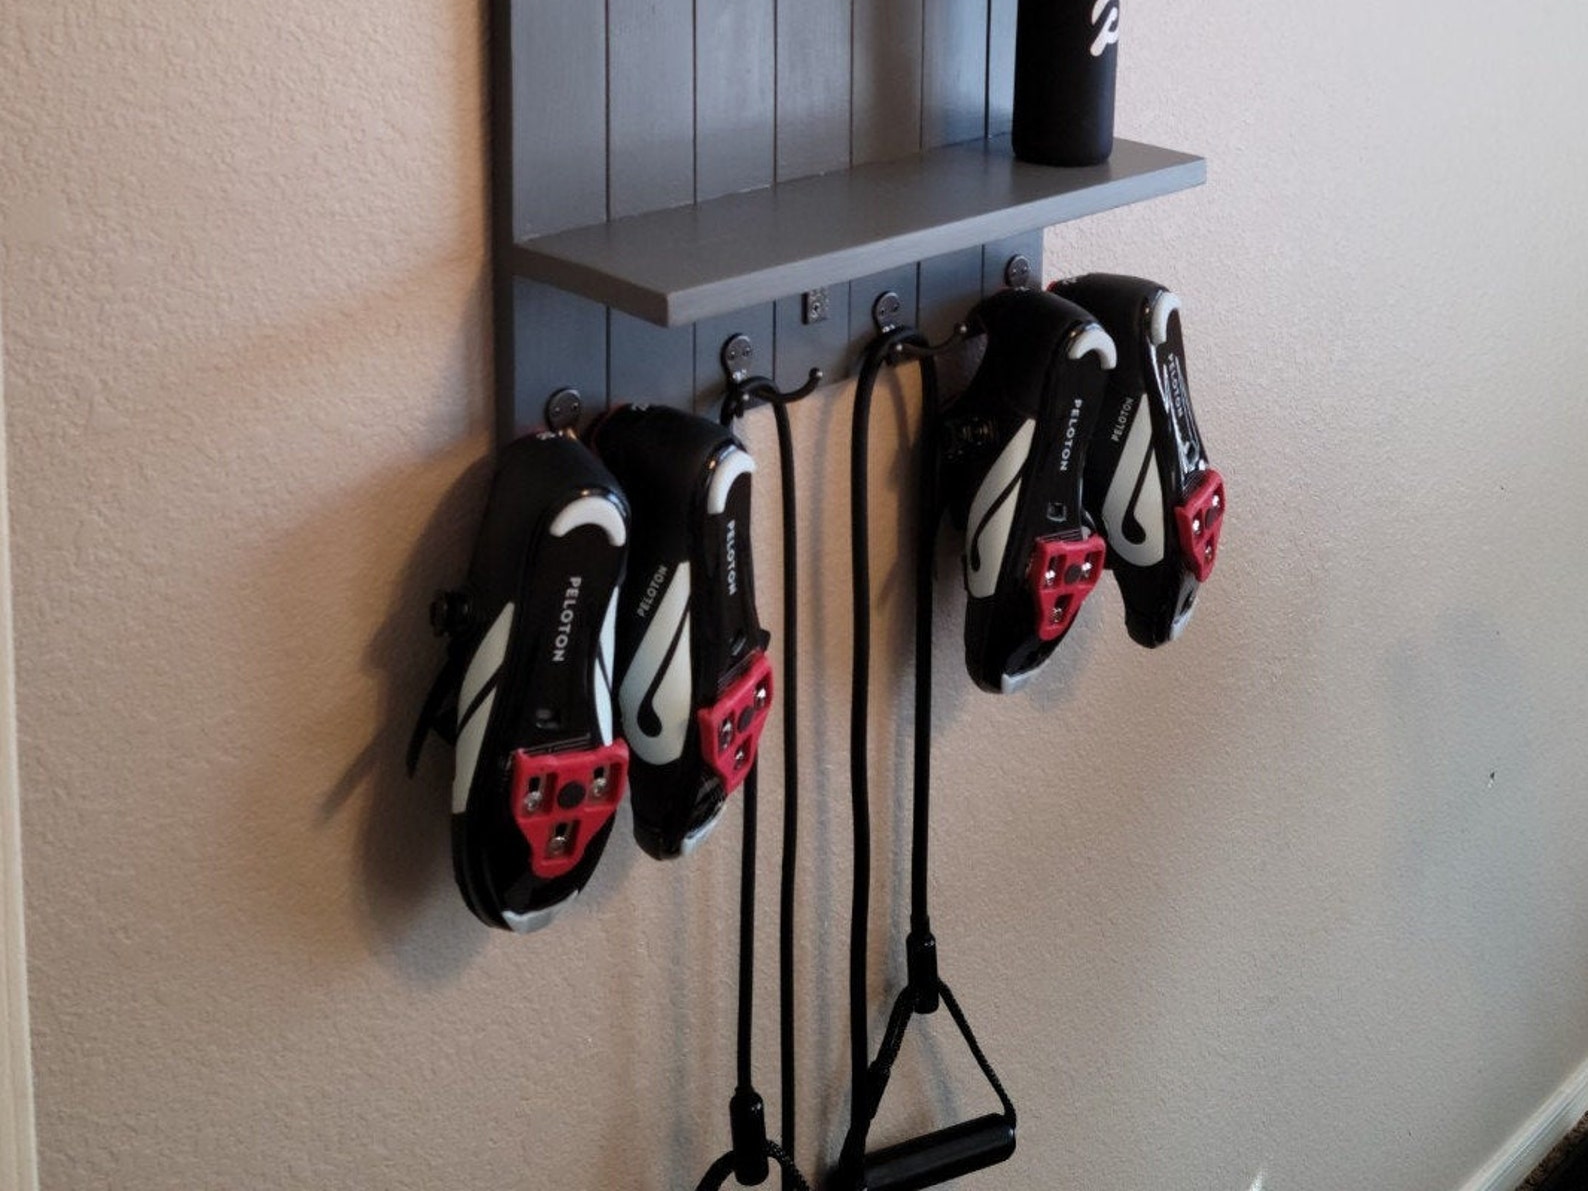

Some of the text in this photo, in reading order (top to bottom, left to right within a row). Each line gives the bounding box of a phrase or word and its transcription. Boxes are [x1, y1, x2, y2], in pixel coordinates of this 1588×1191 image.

[1060, 399, 1082, 470] PELOTON
[637, 565, 667, 617] PELOTON
[726, 519, 736, 595] PELOTON
[552, 577, 581, 661] PELOTON
